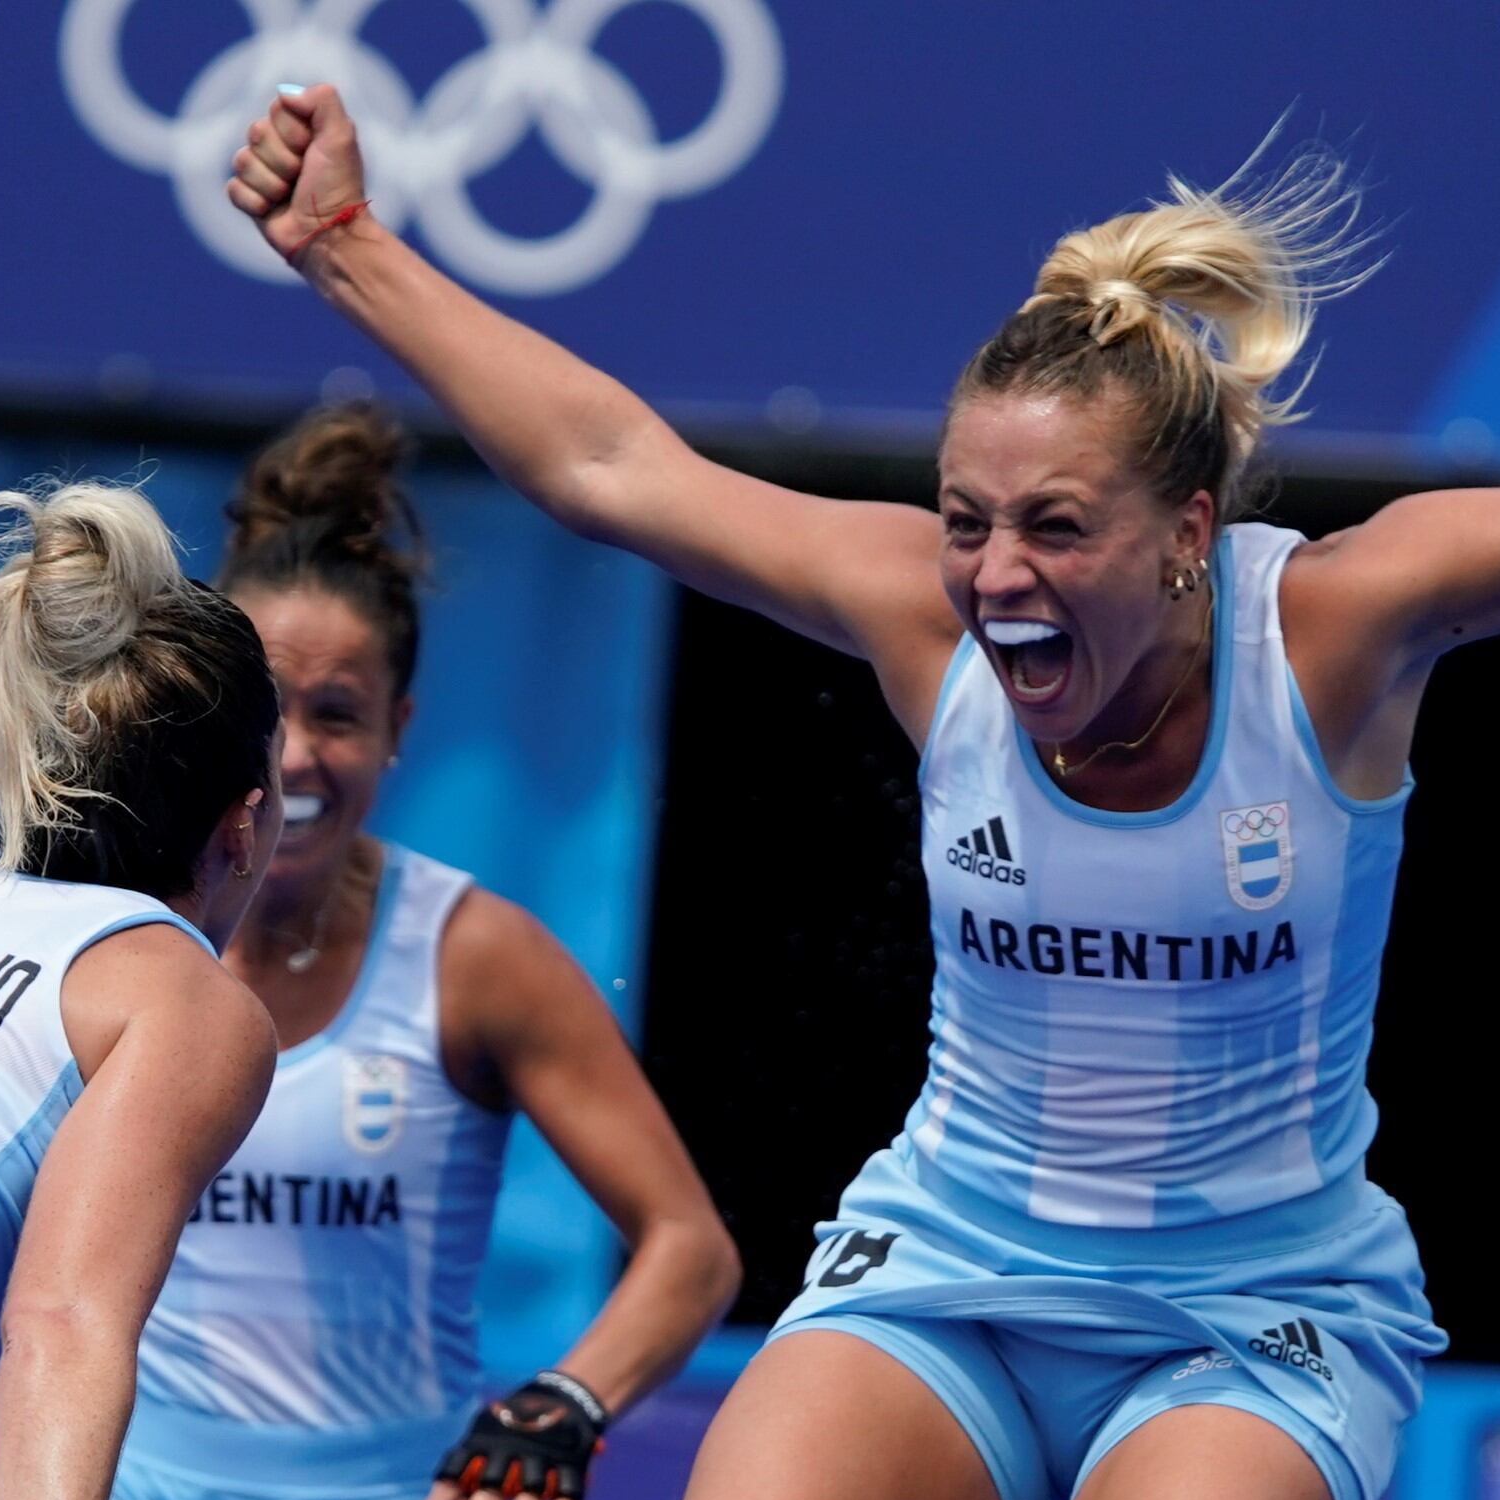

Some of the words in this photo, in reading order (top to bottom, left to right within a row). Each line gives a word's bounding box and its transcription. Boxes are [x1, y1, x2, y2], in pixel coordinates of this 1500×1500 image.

[946, 846, 1026, 886] adidas
[959, 906, 1296, 981] ARGENTINA
[187, 1171, 402, 1228] ENTINA
[1247, 1337, 1334, 1382] adidas
